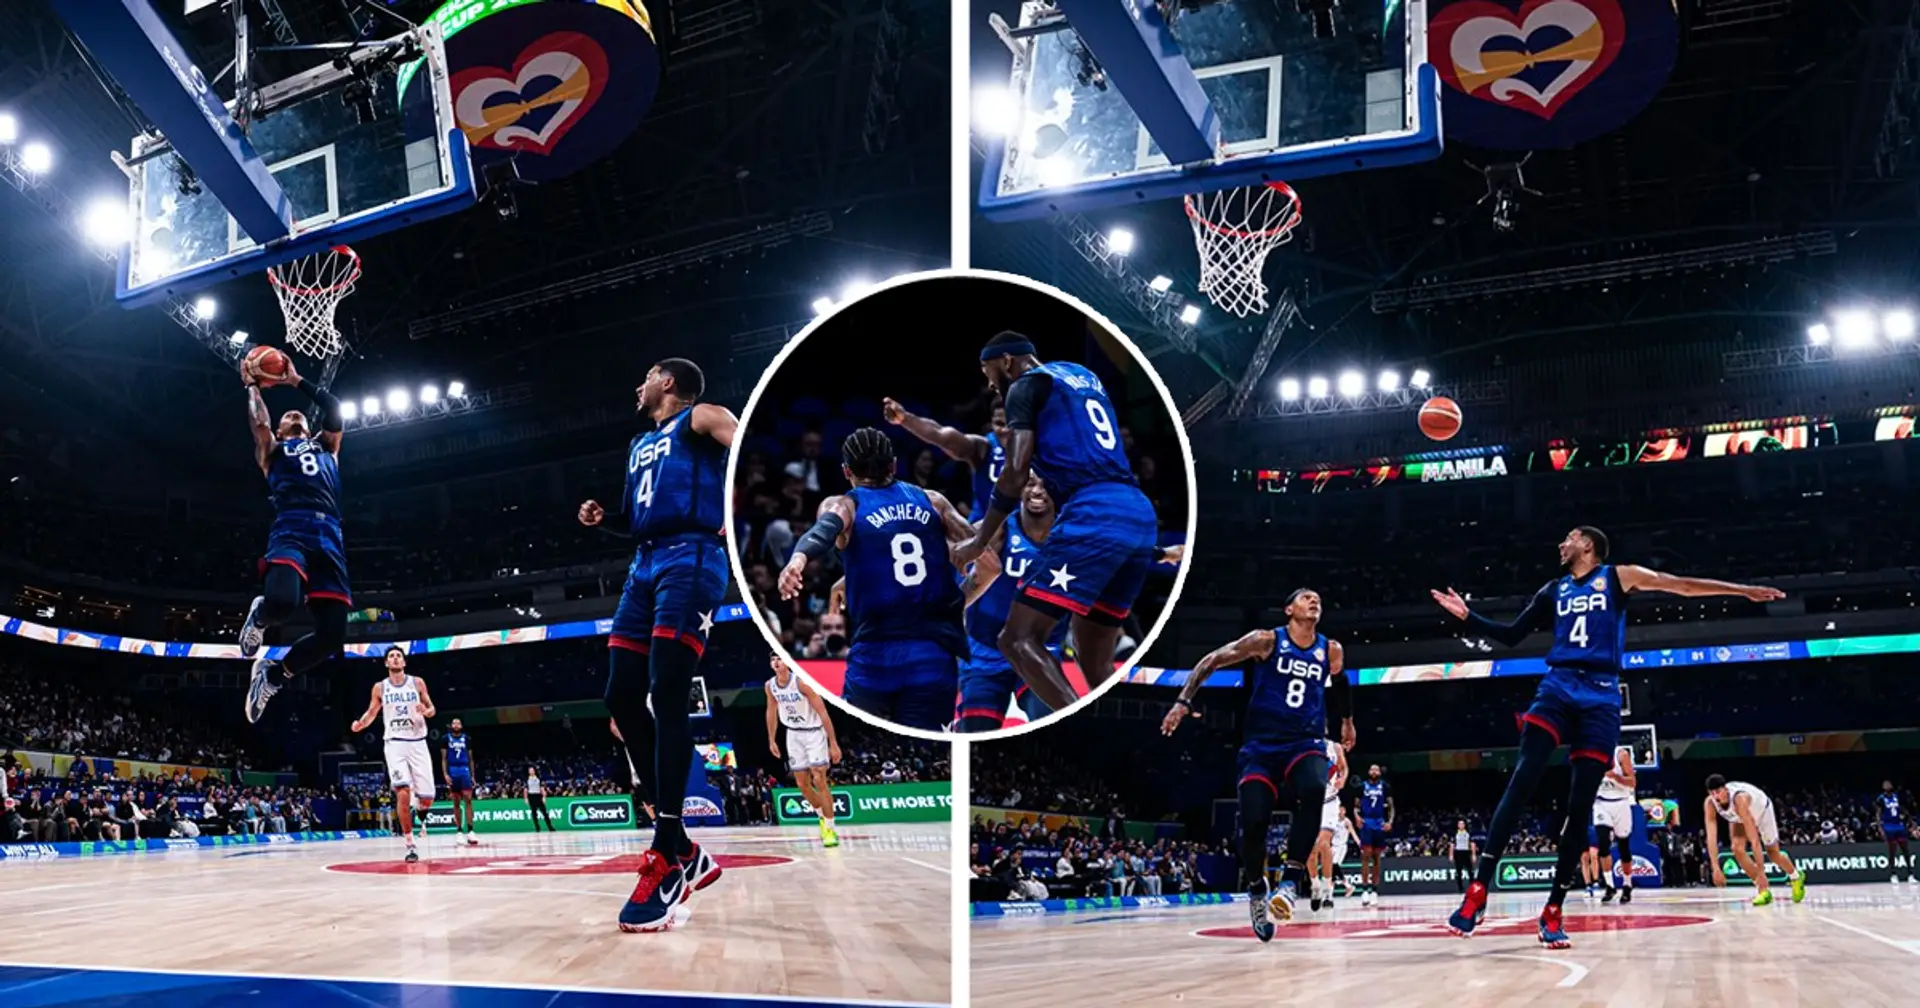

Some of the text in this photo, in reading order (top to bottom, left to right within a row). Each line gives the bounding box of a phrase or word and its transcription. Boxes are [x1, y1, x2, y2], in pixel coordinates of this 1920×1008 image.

[1085, 398, 1117, 451] 9
[299, 453, 320, 476] 8
[629, 436, 672, 474] USA
[1421, 456, 1508, 482] MANILA
[637, 468, 654, 508] 4
[866, 503, 931, 529] BANCHERO
[890, 532, 928, 587] 8
[1557, 593, 1607, 617] USA
[1569, 615, 1589, 648] 4
[1277, 656, 1323, 681] USA
[384, 692, 417, 704] ITALIA
[1285, 678, 1306, 708] 8
[588, 805, 626, 820] Smart
[801, 798, 846, 813] Srt
[859, 798, 890, 811] LIVE
[892, 796, 935, 809] MORE
[1370, 796, 1378, 808] 7
[493, 809, 524, 820] MORE
[1384, 869, 1409, 882] LIVE
[1411, 868, 1447, 881] MORE
[1518, 866, 1557, 881] Smart
[1795, 858, 1824, 872] LIVE
[1826, 857, 1868, 870] MORE
